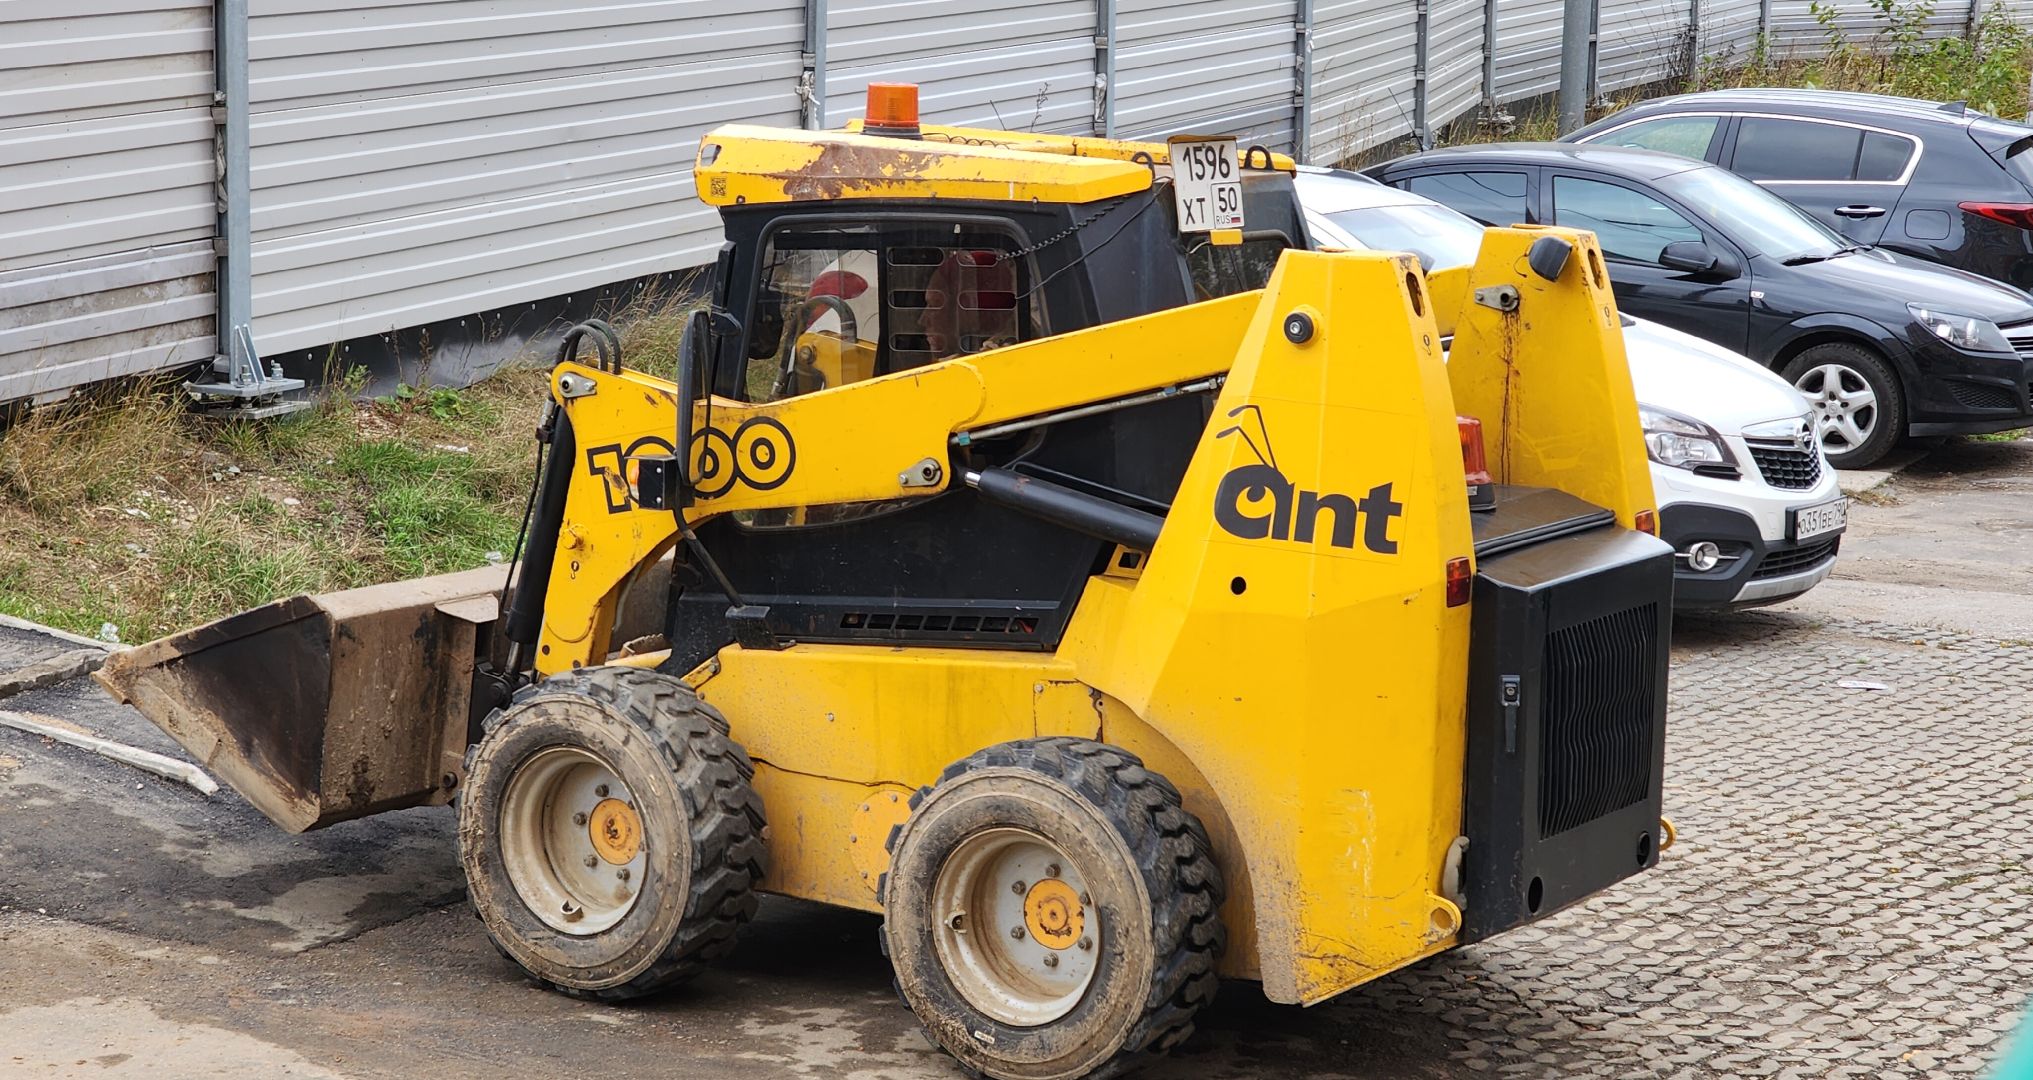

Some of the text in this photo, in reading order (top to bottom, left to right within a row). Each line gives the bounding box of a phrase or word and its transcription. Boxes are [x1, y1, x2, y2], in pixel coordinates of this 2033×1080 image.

[1183, 144, 1231, 181] 1596
[1218, 187, 1237, 213] 50
[1216, 215, 1230, 224] RUS
[1214, 464, 1403, 555] ant
